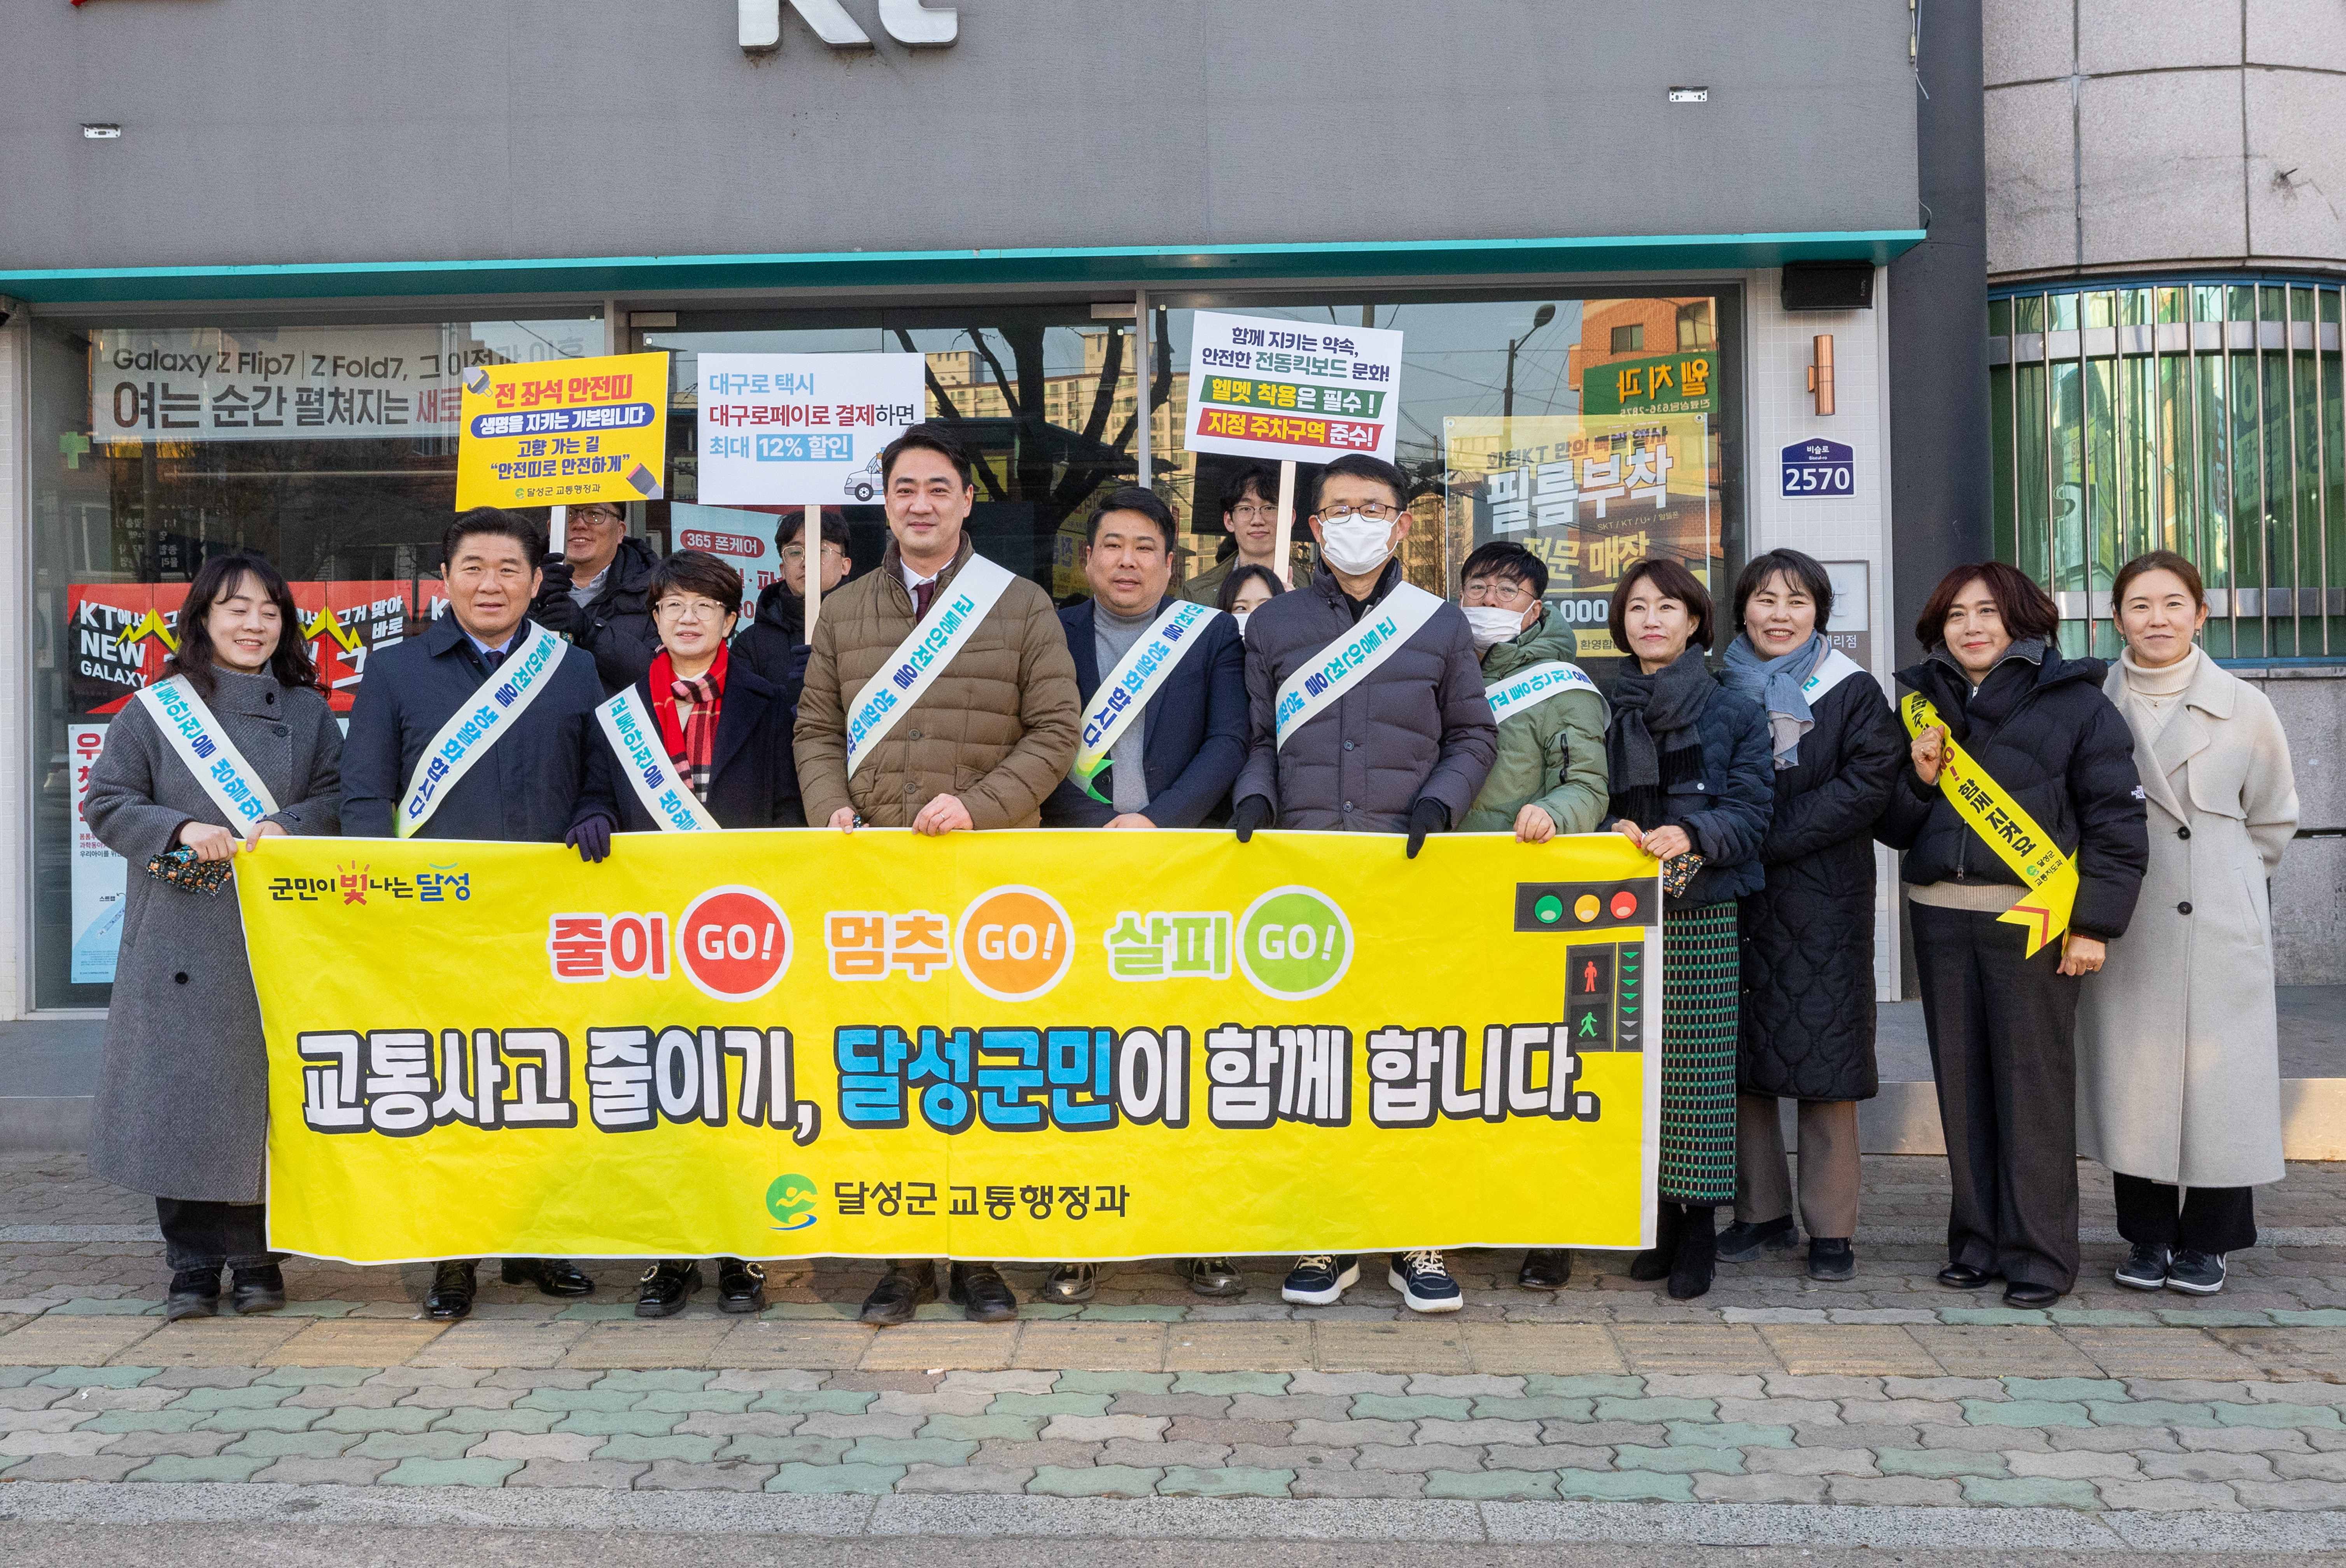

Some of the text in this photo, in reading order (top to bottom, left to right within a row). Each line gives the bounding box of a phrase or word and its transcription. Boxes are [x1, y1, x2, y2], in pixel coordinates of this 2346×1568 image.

[1232, 327, 1359, 358] 함께 지키는 약속,
[113, 348, 212, 378] Galaxy
[216, 352, 231, 373] Z
[238, 350, 295, 381] Flip7
[312, 355, 326, 377] Z
[333, 355, 408, 382] Fold7,
[419, 355, 440, 380] 그
[1202, 347, 1390, 382] 안전한 전동킥보드 문화!
[495, 374, 633, 408] 전 좌석 안전띠
[709, 373, 814, 395] 대구로 택시
[1212, 378, 1251, 403] 헬멧
[1258, 383, 1317, 410] 착용은
[1323, 389, 1361, 413] 필수
[113, 382, 462, 429] 여는 순간 펼쳐지는 새로
[480, 406, 646, 435] 생명을 지키는 기본입니다
[709, 404, 914, 427] 대구로페이로 결제하면
[1207, 412, 1373, 447] 지정 주차구역 준수!
[517, 436, 599, 458] 고향 가는 길
[709, 435, 848, 459] 최대 12% 할인
[1807, 445, 1830, 454] 비슬로
[490, 454, 630, 480] “안전띠로 안전하게”
[1786, 467, 1850, 491] 2570
[527, 484, 601, 497] 달성군 교통행정과
[1486, 444, 1673, 535] 필름부착
[1597, 522, 1613, 531] SKT
[1621, 519, 1632, 527] KT
[1658, 511, 1679, 521] 알뜰폰
[687, 533, 757, 555] 365 폰케어
[337, 605, 367, 627] 그거
[371, 595, 403, 619] 맞아
[372, 616, 403, 639] 바로
[81, 629, 146, 668] NEW
[1304, 616, 1397, 698] 교통안전을
[1580, 639, 1617, 650] 환영합
[81, 661, 148, 689] GALAXY
[851, 594, 975, 742] 교통안전을 생활화
[1083, 603, 1207, 749] 안전을 생활화 합시다
[1488, 670, 1592, 712] 교통안전을
[440, 705, 499, 764] 생활화
[608, 696, 702, 830] 교통안전을 생활
[210, 758, 264, 821] 생활화
[408, 757, 451, 819] 합시다
[1957, 778, 1994, 814] 함께
[1985, 807, 2036, 858] 지켜요
[2034, 859, 2063, 887] 교통지도과
[2037, 850, 2055, 867] 달성군
[552, 915, 1335, 978] 줄이 GO! 멈추 GO! 살피 GO!
[299, 1026, 1598, 1143] 교통사고 줄이기, 달성군민이 함께 합니다.
[834, 1181, 1130, 1221] 달성군 교통행정과
